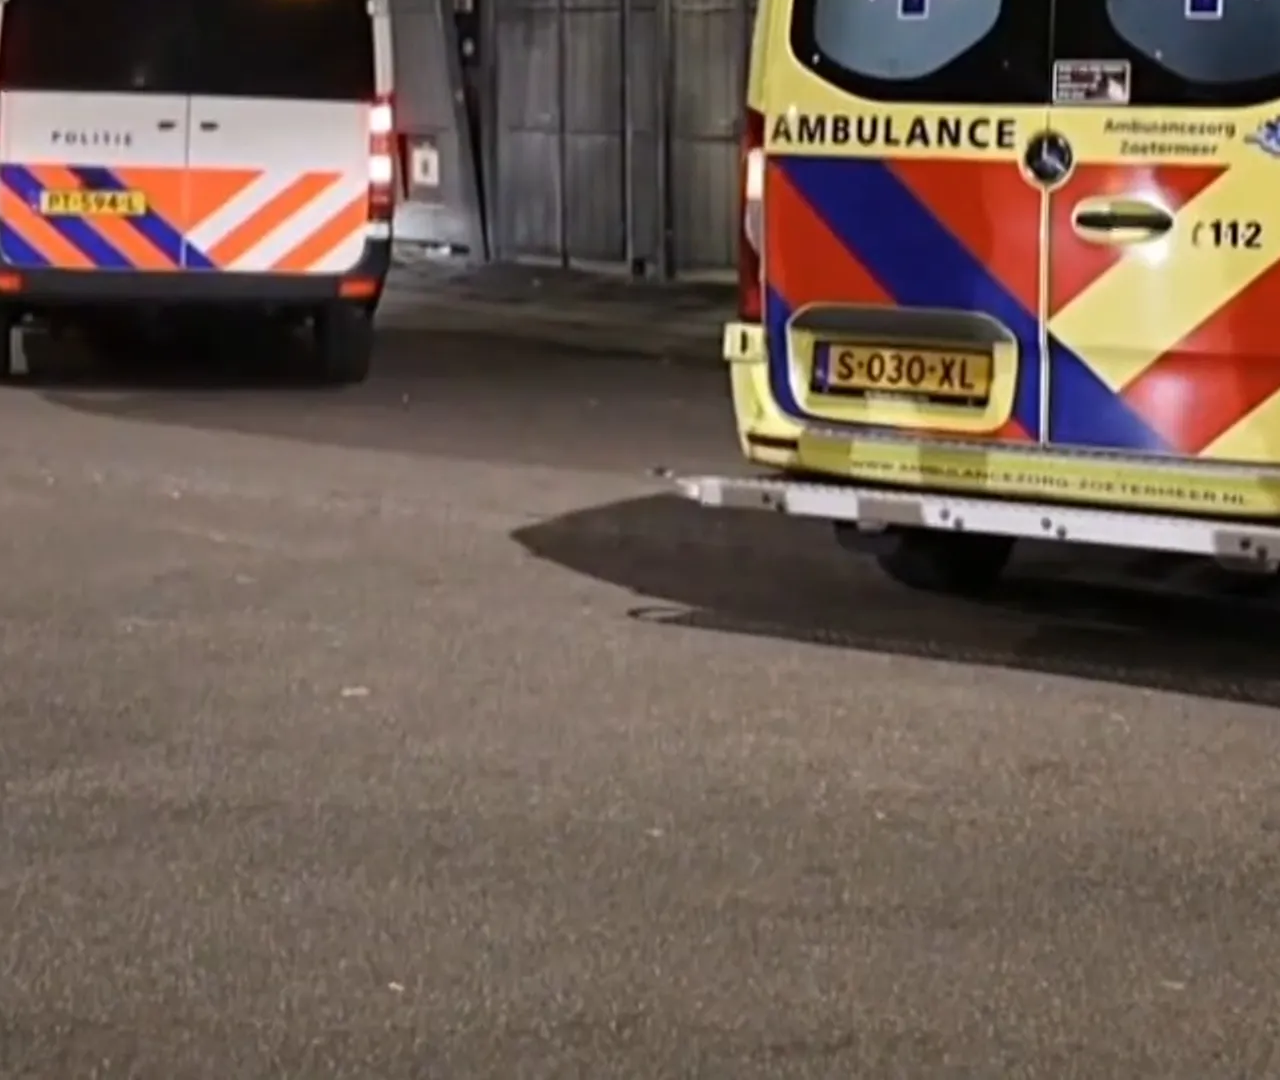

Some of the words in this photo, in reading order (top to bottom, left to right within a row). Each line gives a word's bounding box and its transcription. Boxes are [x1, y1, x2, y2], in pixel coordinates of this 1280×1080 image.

[50, 129, 133, 147] POLITIE
[771, 113, 1017, 150] AMBULANCE
[1103, 116, 1237, 139] Ambulancezorg
[1119, 140, 1219, 156] Zoetermeer
[836, 350, 976, 390] S-030-XL
